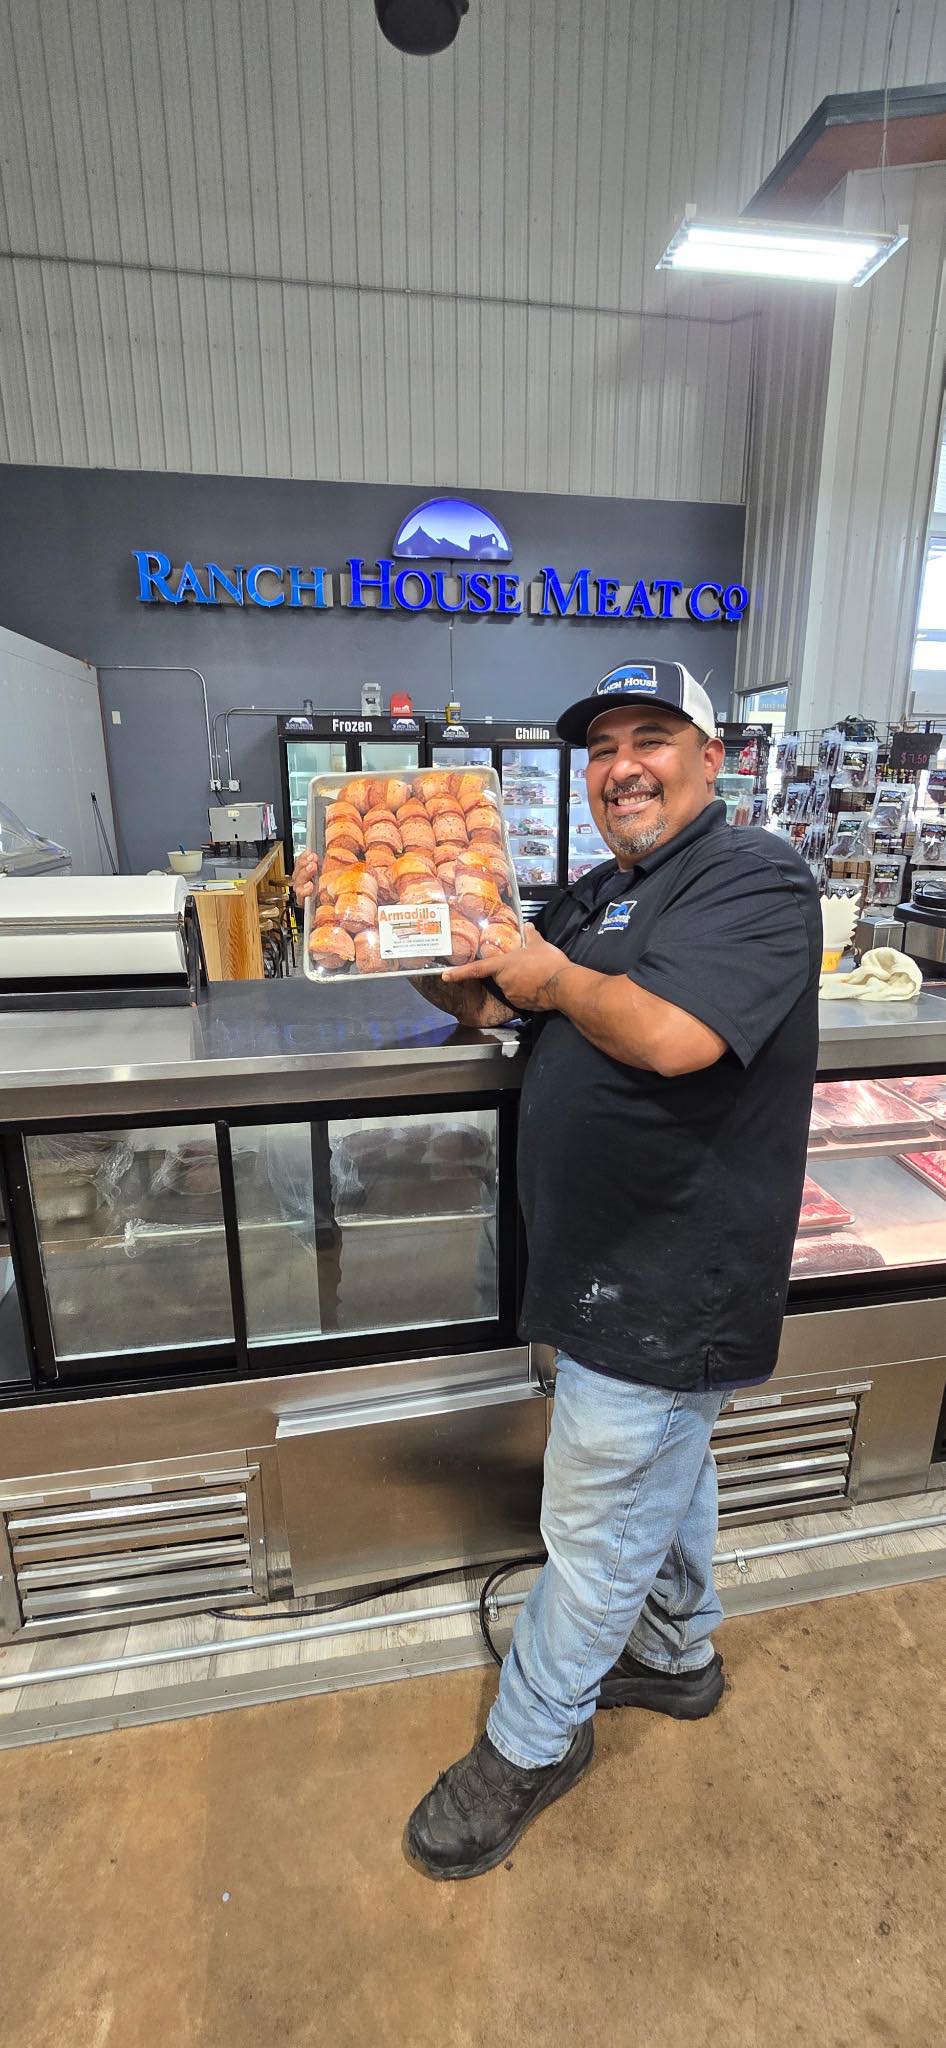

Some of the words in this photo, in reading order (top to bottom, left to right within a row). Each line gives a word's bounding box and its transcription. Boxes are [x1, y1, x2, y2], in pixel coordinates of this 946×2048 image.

[132, 551, 327, 608] RANCH
[347, 558, 523, 612] HOUSE
[540, 567, 683, 618] MEAT
[332, 719, 373, 733] Frozen
[515, 727, 550, 740] Chillin
[379, 907, 436, 922] Armadillo
